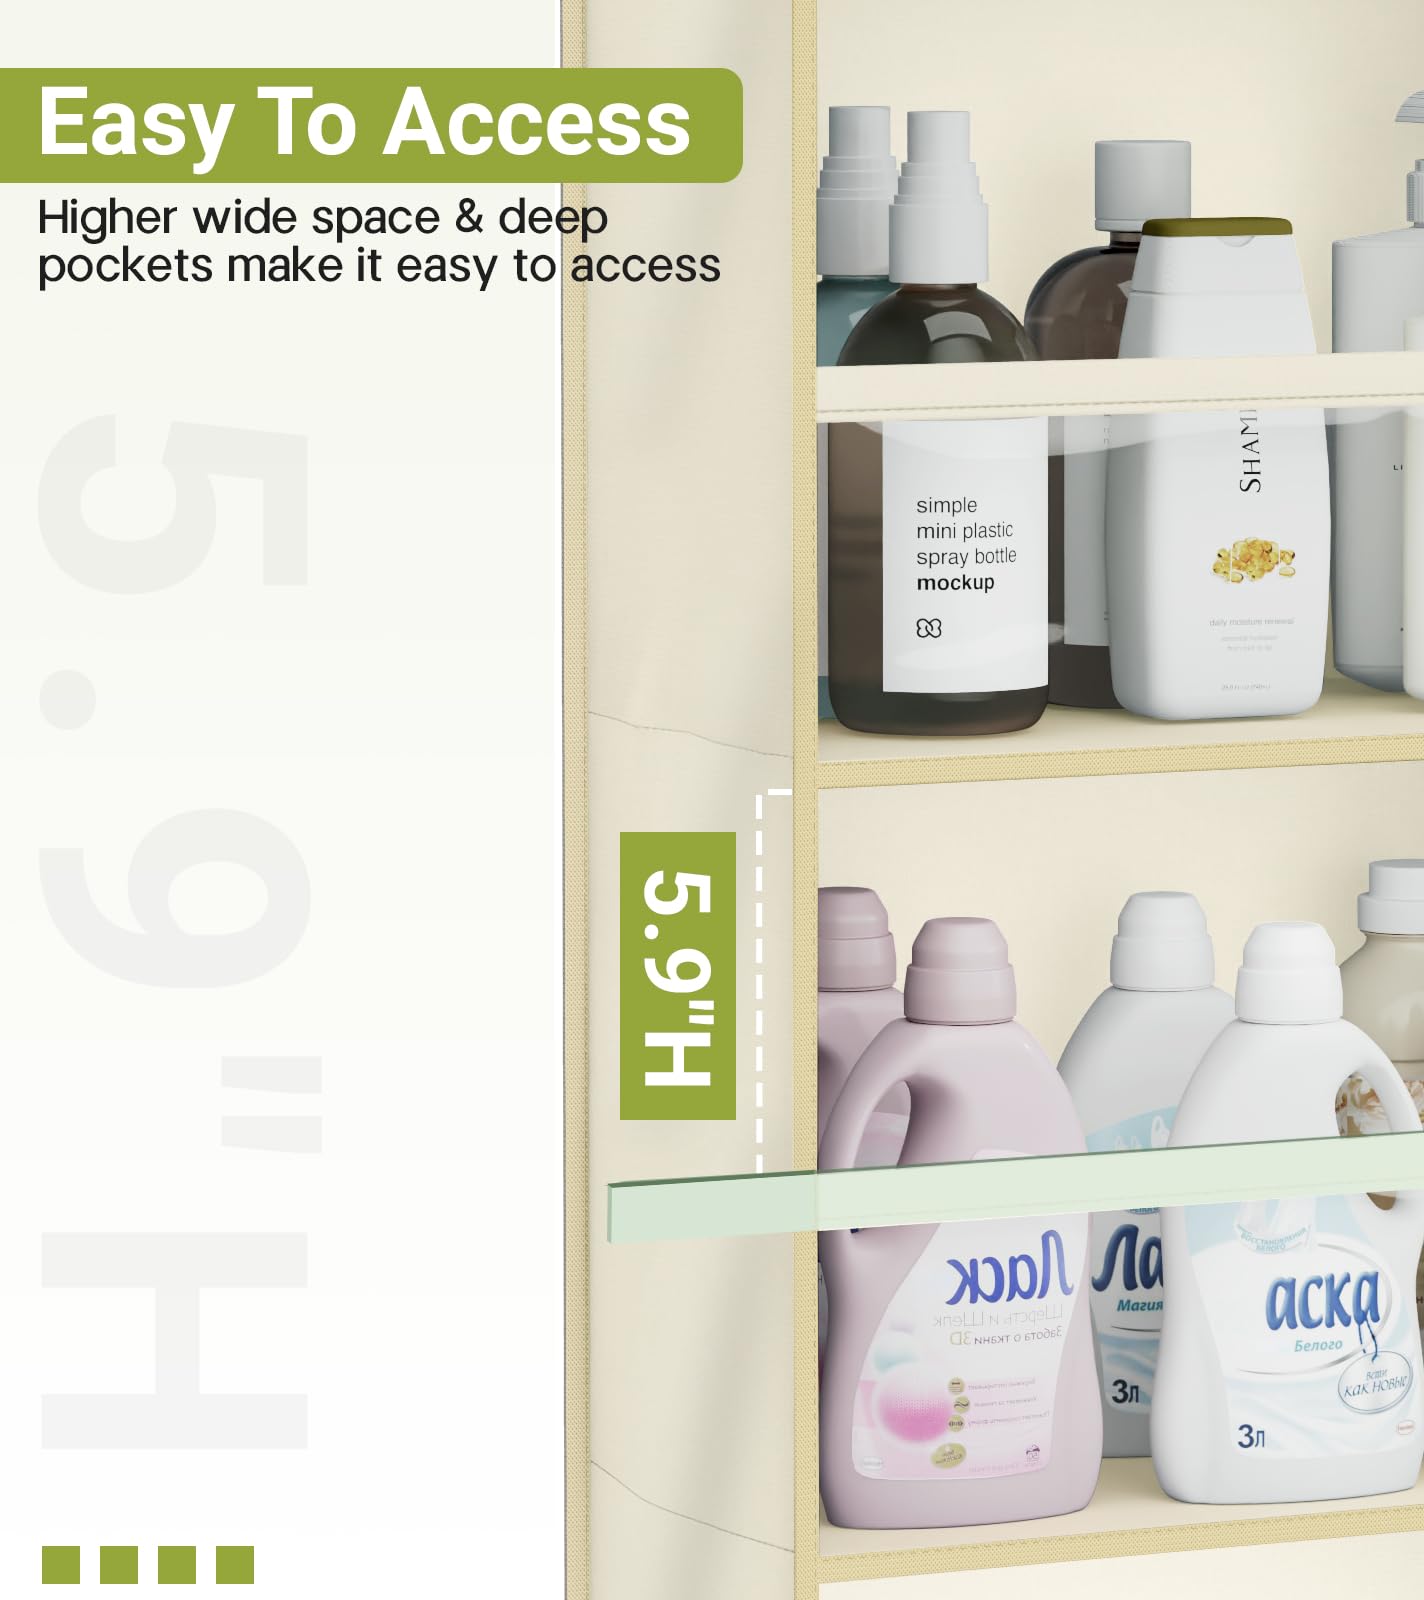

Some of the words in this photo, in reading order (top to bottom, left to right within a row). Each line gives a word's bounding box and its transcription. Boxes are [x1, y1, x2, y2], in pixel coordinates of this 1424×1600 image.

[916, 496, 978, 517] simple
[917, 522, 957, 539] mini
[963, 521, 1014, 542] plastic
[916, 552, 969, 569] spray
[975, 546, 1017, 564] bottle
[917, 574, 995, 594] mockup
[1116, 1299, 1164, 1312] Магия
[1265, 1271, 1381, 1331] аска
[1294, 1339, 1343, 1353] Белого
